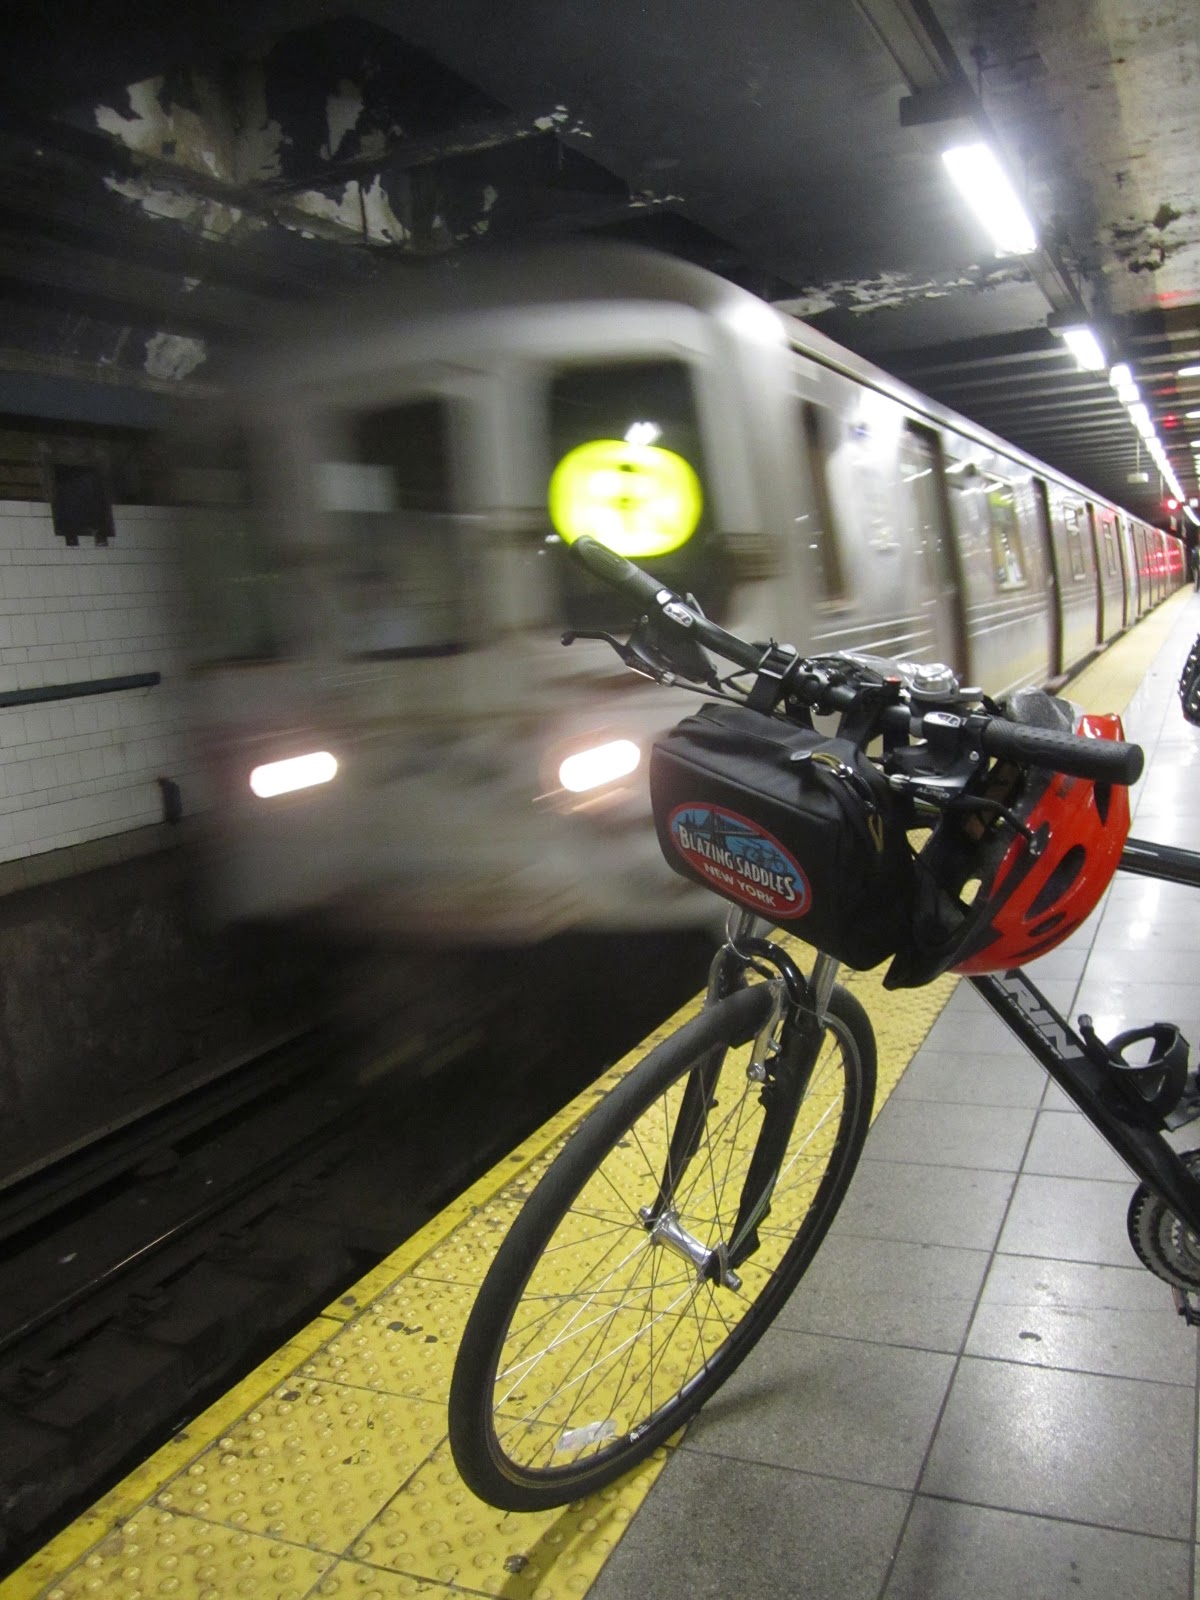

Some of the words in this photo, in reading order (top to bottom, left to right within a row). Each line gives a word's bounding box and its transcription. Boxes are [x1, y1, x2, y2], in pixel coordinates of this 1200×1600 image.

[678, 824, 734, 870] BLAZING
[736, 856, 796, 901] SADDLES
[703, 863, 734, 885] NEW
[737, 880, 777, 907] YORK
